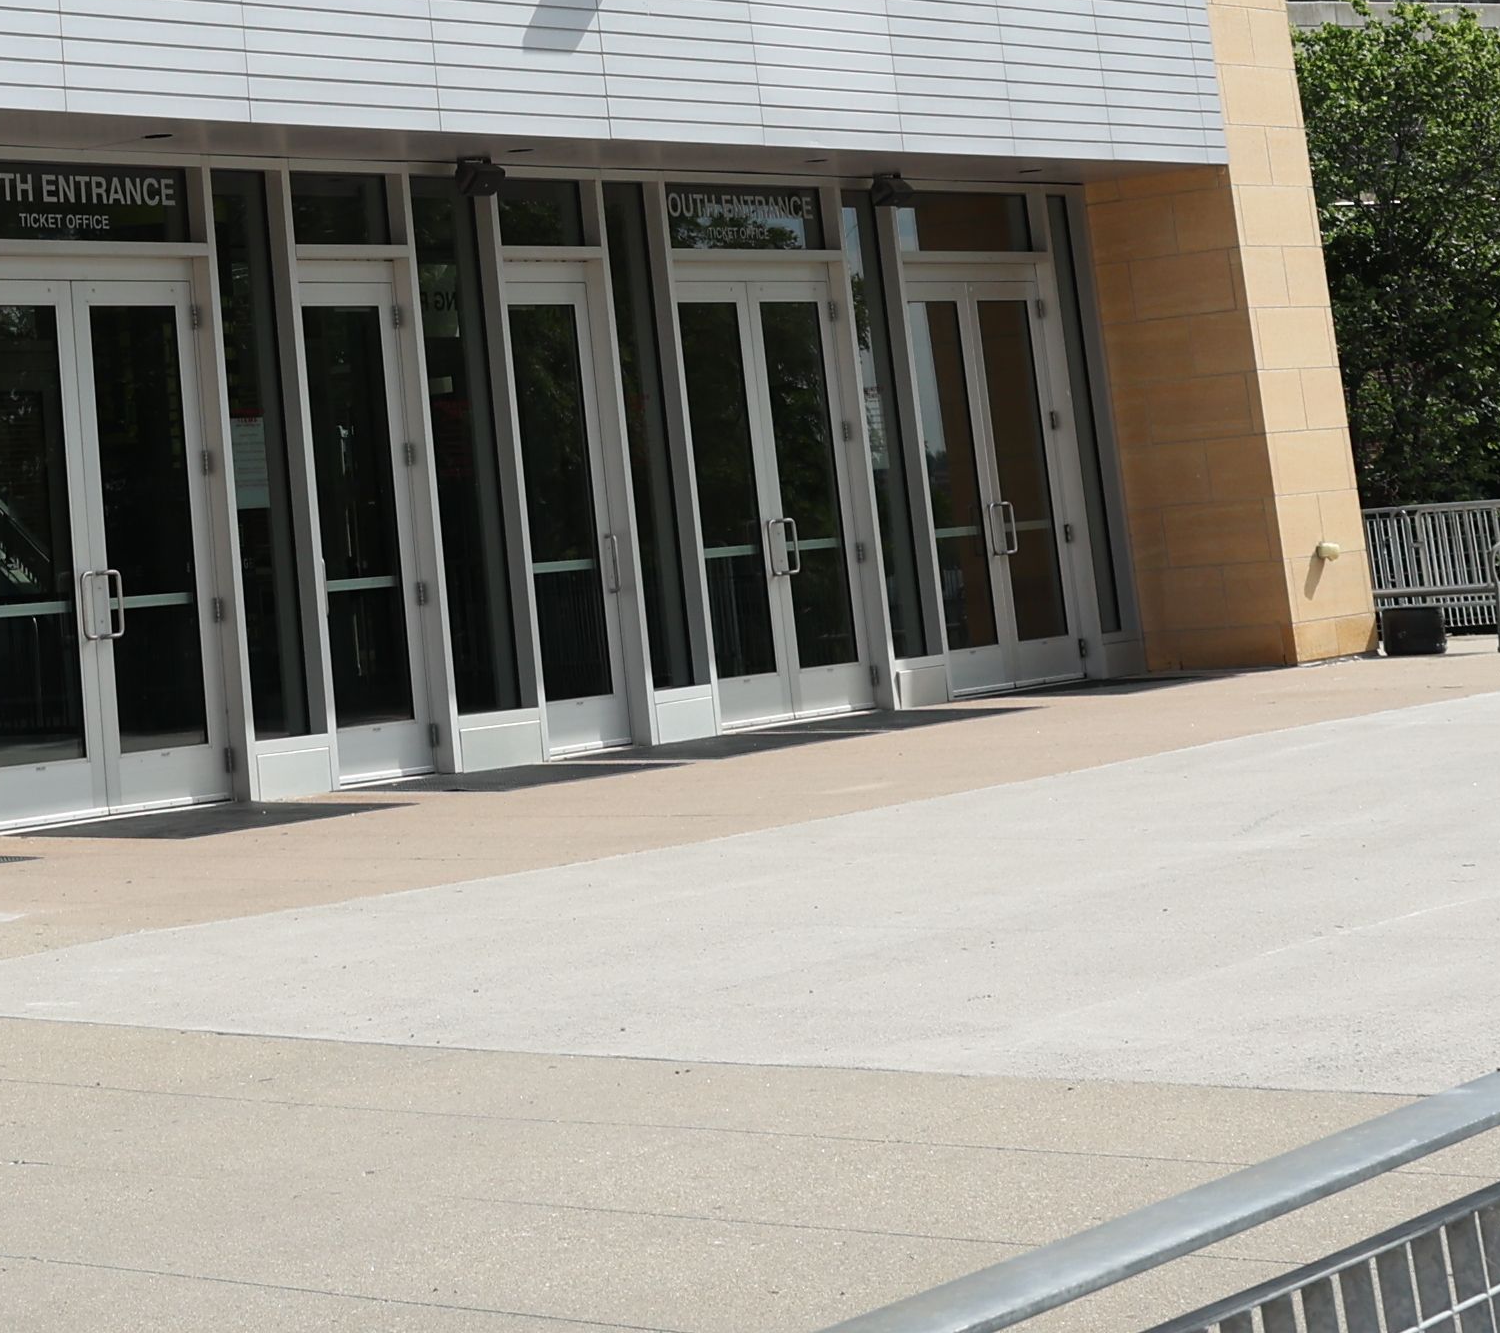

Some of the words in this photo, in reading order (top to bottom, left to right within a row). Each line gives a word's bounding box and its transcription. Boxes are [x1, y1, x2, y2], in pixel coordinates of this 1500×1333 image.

[42, 174, 176, 206] ENTRANCE
[668, 192, 717, 217] OUTH
[721, 194, 814, 220] ENTRANCE
[19, 213, 63, 230] TICKET
[66, 214, 110, 230] OFFICE
[708, 227, 738, 240] TICKET
[740, 228, 770, 240] OFFICE
